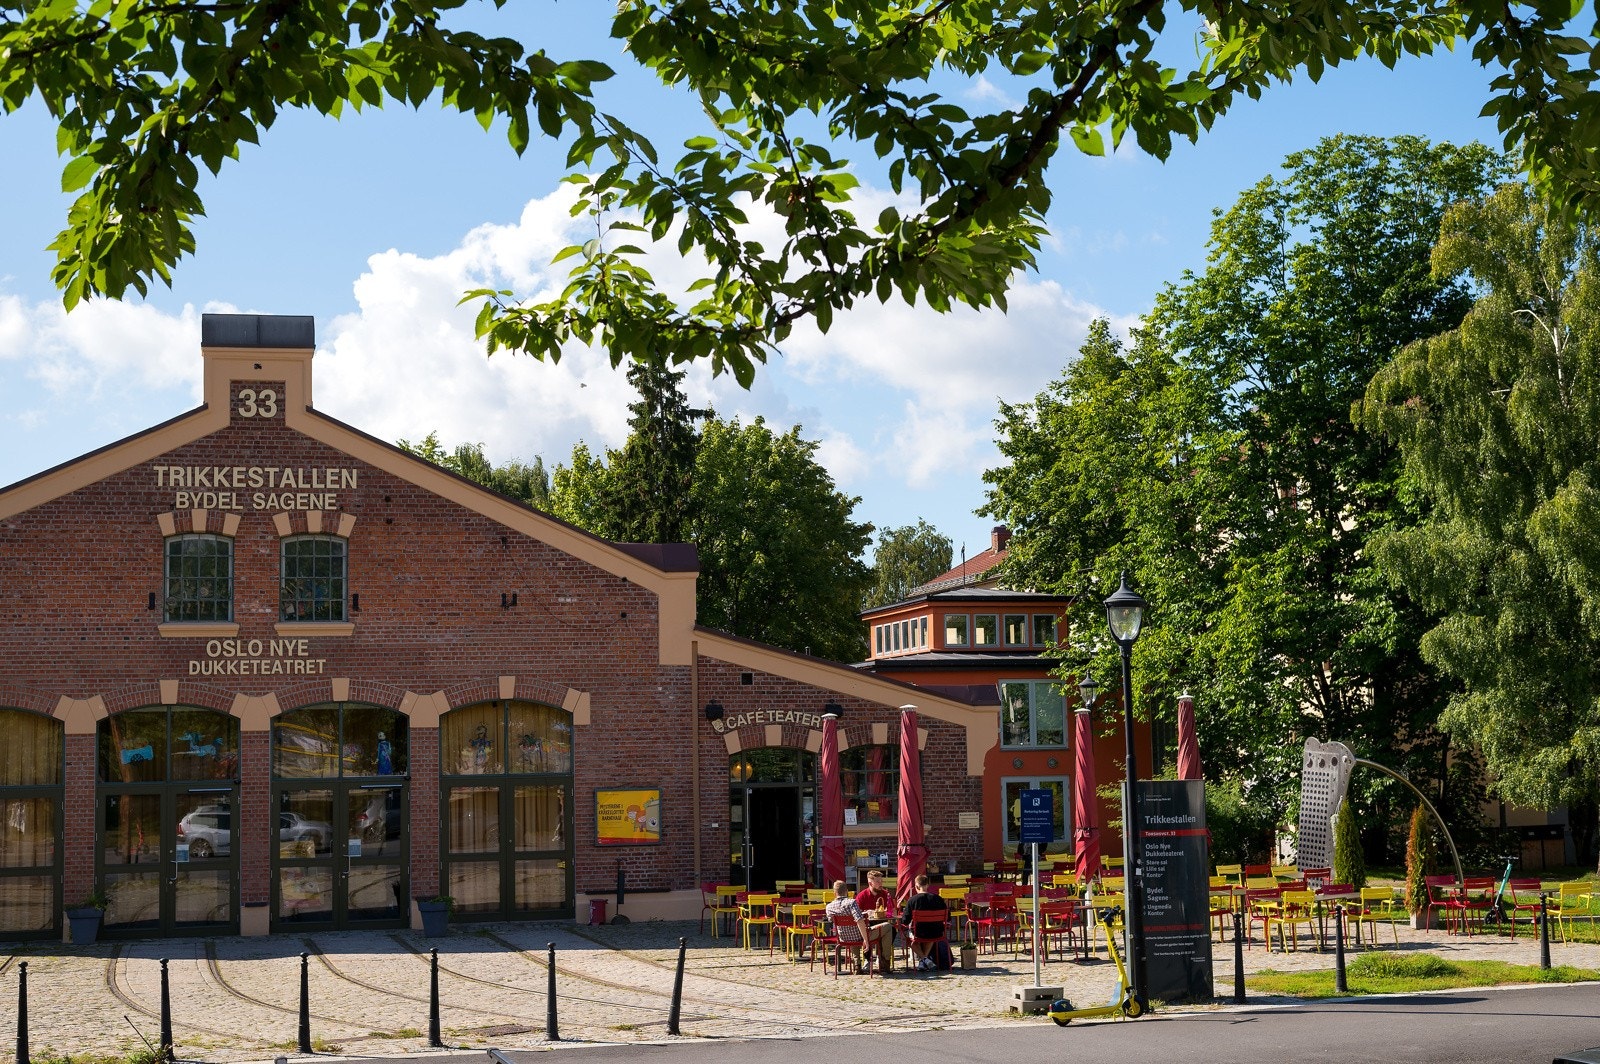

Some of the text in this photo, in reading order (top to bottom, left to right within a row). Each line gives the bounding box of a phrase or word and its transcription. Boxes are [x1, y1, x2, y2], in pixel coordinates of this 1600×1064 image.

[238, 389, 278, 418] 33
[153, 466, 358, 489] TRIKKESTALLEN
[175, 491, 337, 510] BYDEL SAGENE
[206, 639, 309, 657] OSLO NYE
[189, 659, 326, 675] DUKKETEATRET
[726, 707, 822, 729] CAFÉ TEATER
[1144, 815, 1196, 824] Trikkestallen
[1159, 843, 1171, 851] Nye
[1147, 887, 1163, 895] Bydel
